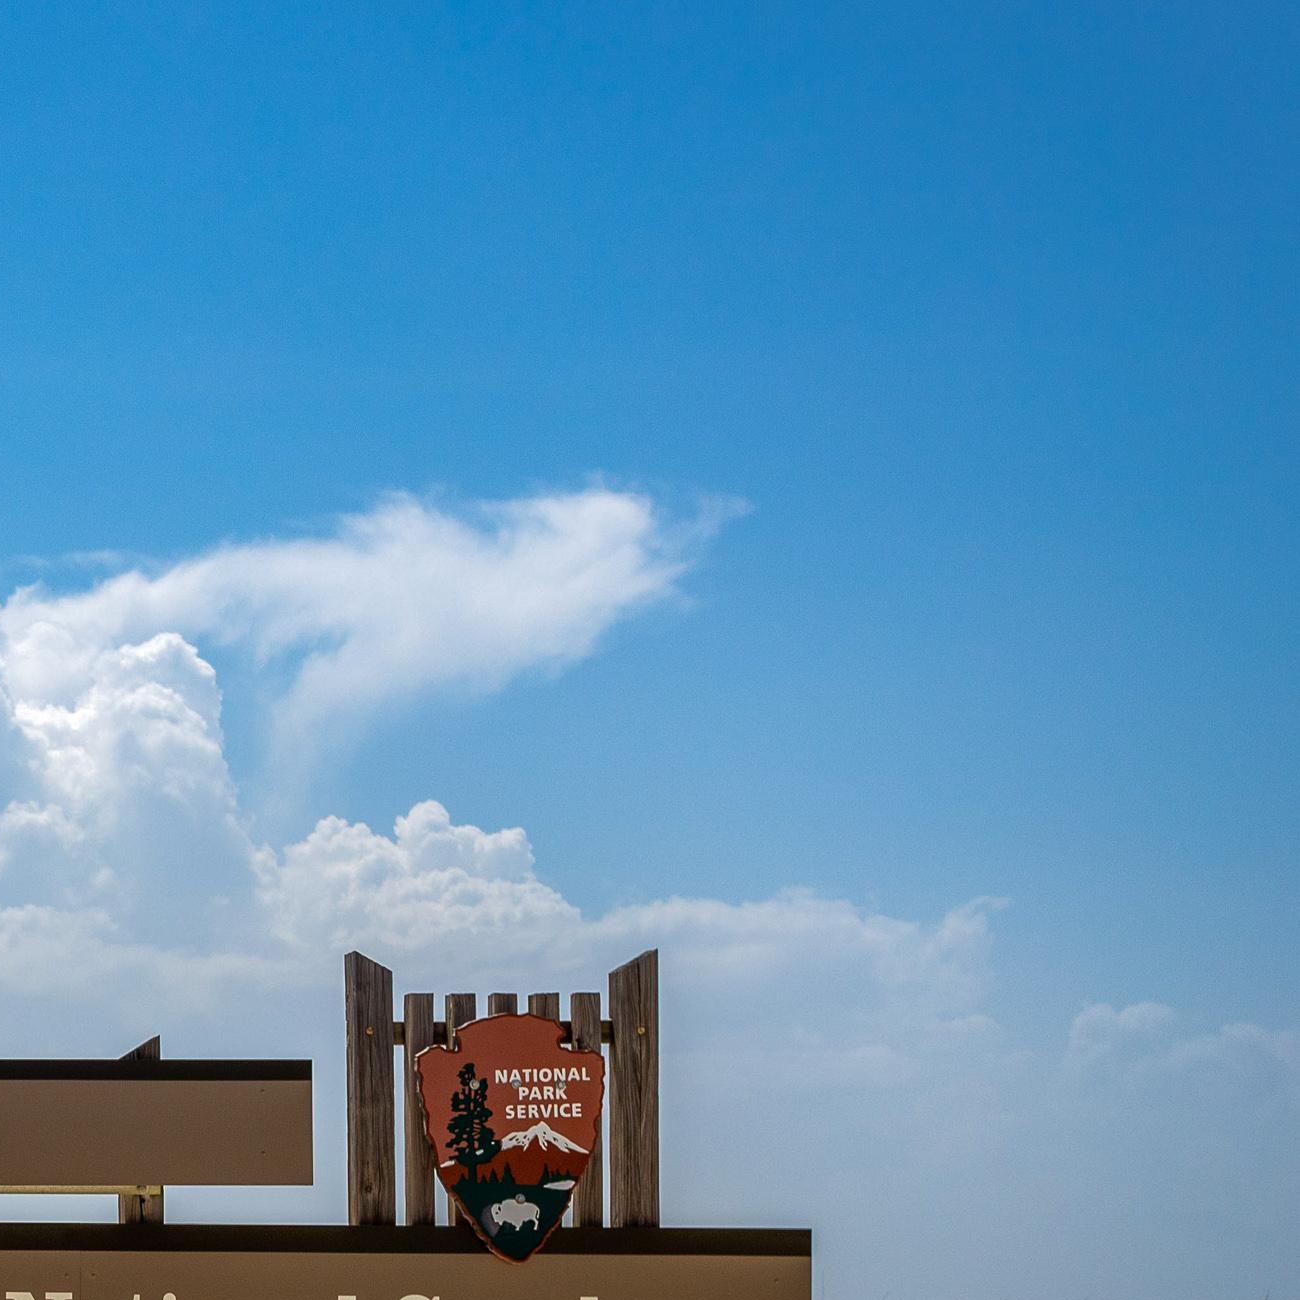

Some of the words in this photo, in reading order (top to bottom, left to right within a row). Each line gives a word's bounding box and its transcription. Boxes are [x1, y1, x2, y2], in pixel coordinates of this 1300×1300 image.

[495, 1067, 591, 1084] NATIONAL
[518, 1086, 567, 1101] PARK
[505, 1103, 582, 1119] SERVICE
